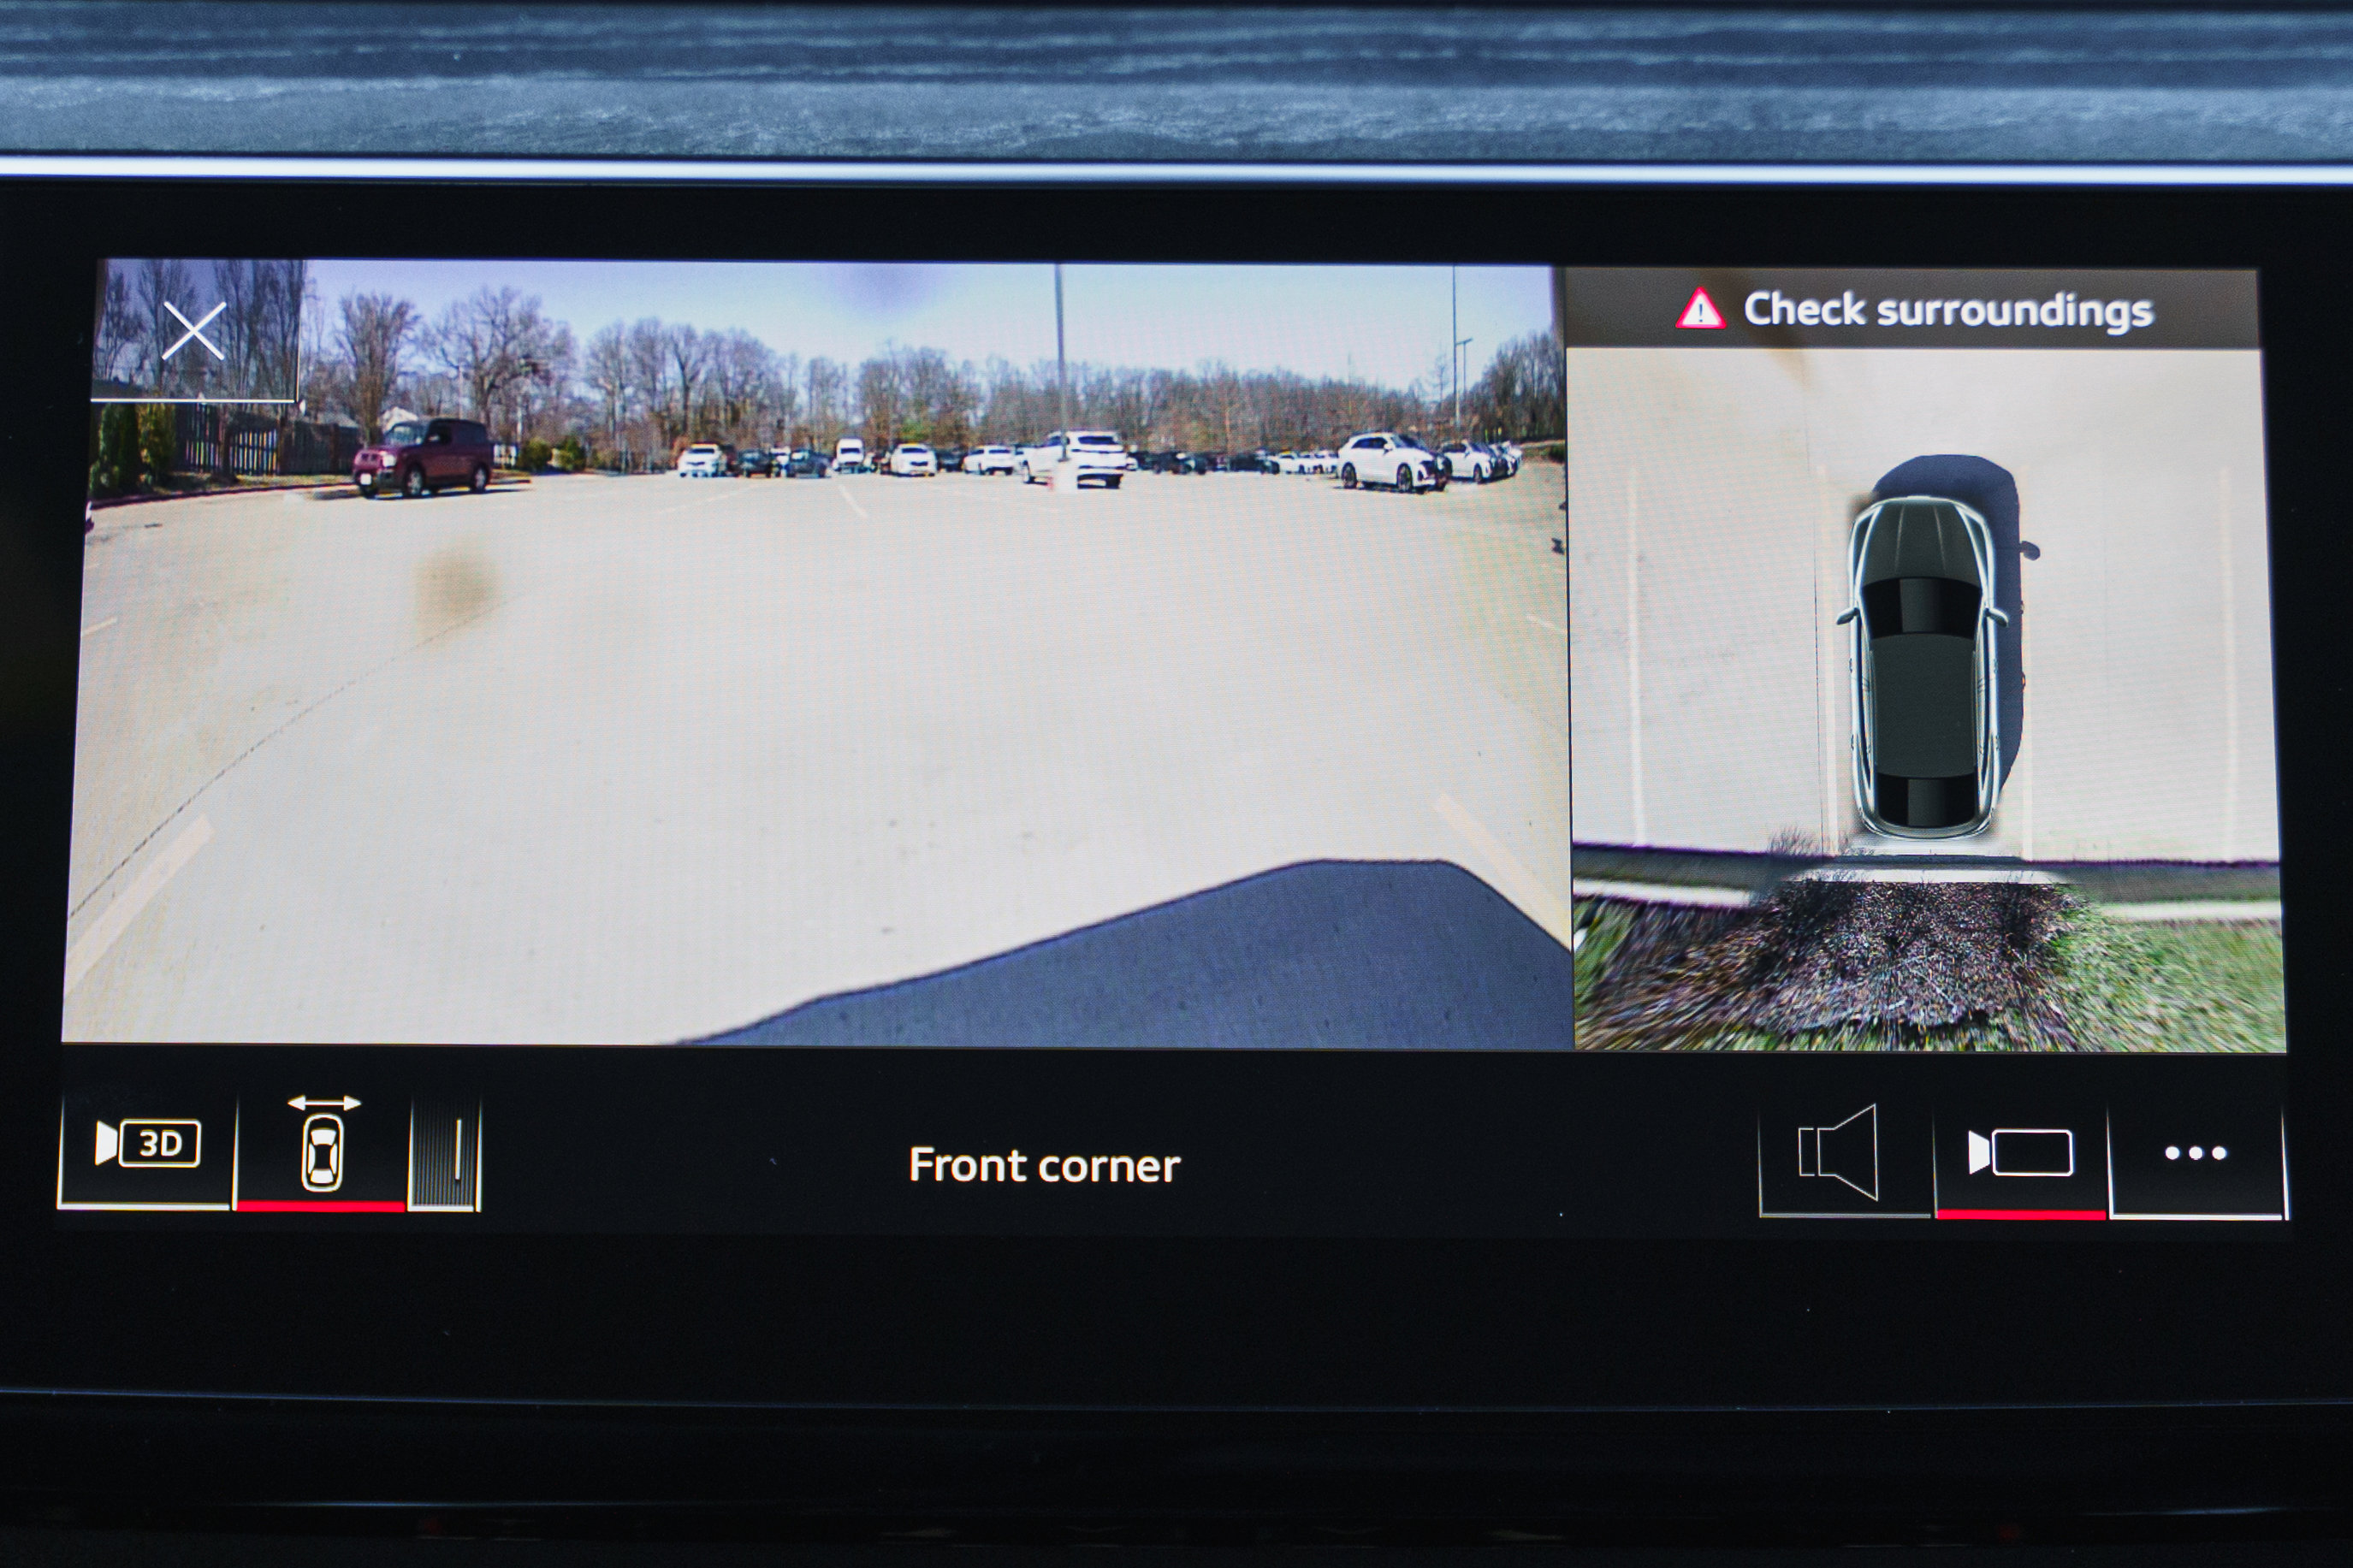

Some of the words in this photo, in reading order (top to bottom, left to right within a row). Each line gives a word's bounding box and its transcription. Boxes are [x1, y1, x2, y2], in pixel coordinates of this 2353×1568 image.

[1745, 290, 1867, 326] Check
[1877, 291, 2154, 336] surroundings
[139, 1129, 183, 1157] 3D
[910, 1146, 1028, 1182] Front
[1039, 1155, 1182, 1183] corner
